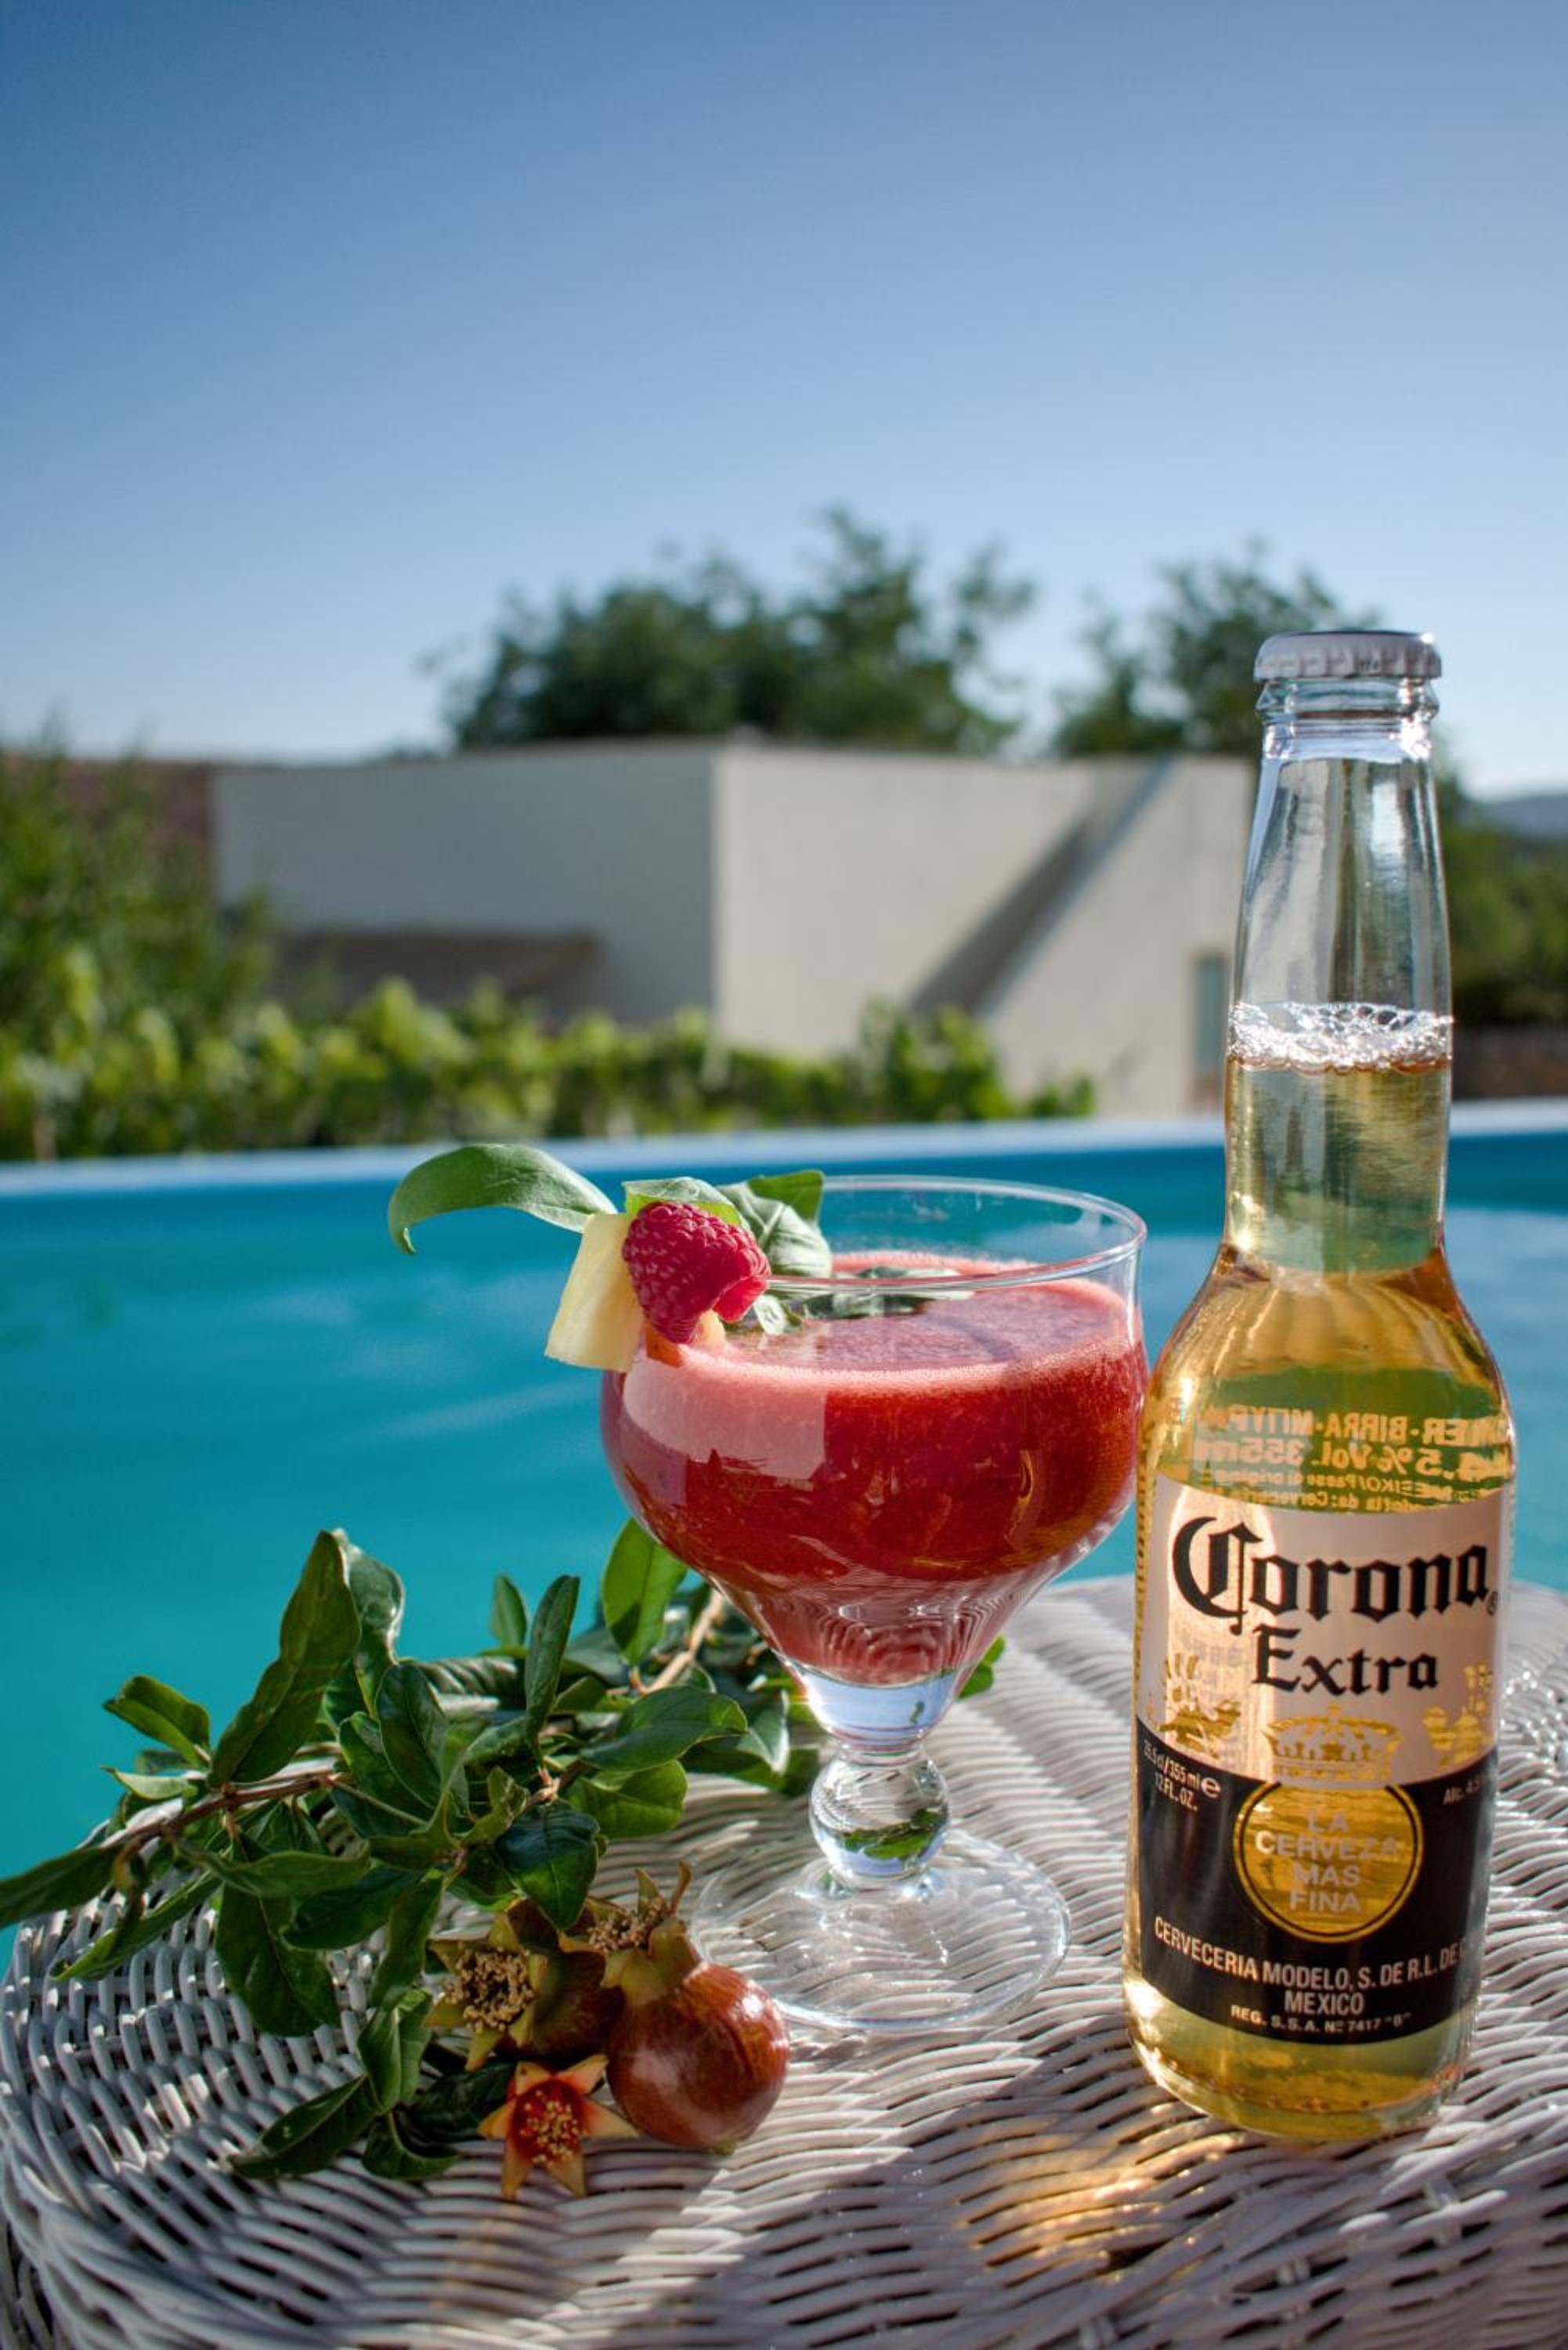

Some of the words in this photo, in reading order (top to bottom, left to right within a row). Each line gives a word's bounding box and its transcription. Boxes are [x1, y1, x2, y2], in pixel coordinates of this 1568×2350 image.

[1172, 1516, 1488, 1636] Corona
[1251, 1622, 1440, 1697] Extra
[1308, 1808, 1349, 1833] LA
[1255, 1830, 1399, 1861] CERVEZA
[1293, 1860, 1361, 1888] MAS
[1291, 1891, 1362, 1913] FINA
[1154, 1915, 1259, 1982] CERVECERIA
[1262, 1960, 1353, 1992] MODELO,
[1357, 1966, 1376, 1990] S.
[1379, 1961, 1405, 1987] DE
[1407, 1954, 1439, 1982] R.L.
[1230, 2003, 1266, 2026] REG.
[1284, 1990, 1364, 2016] MEXICO
